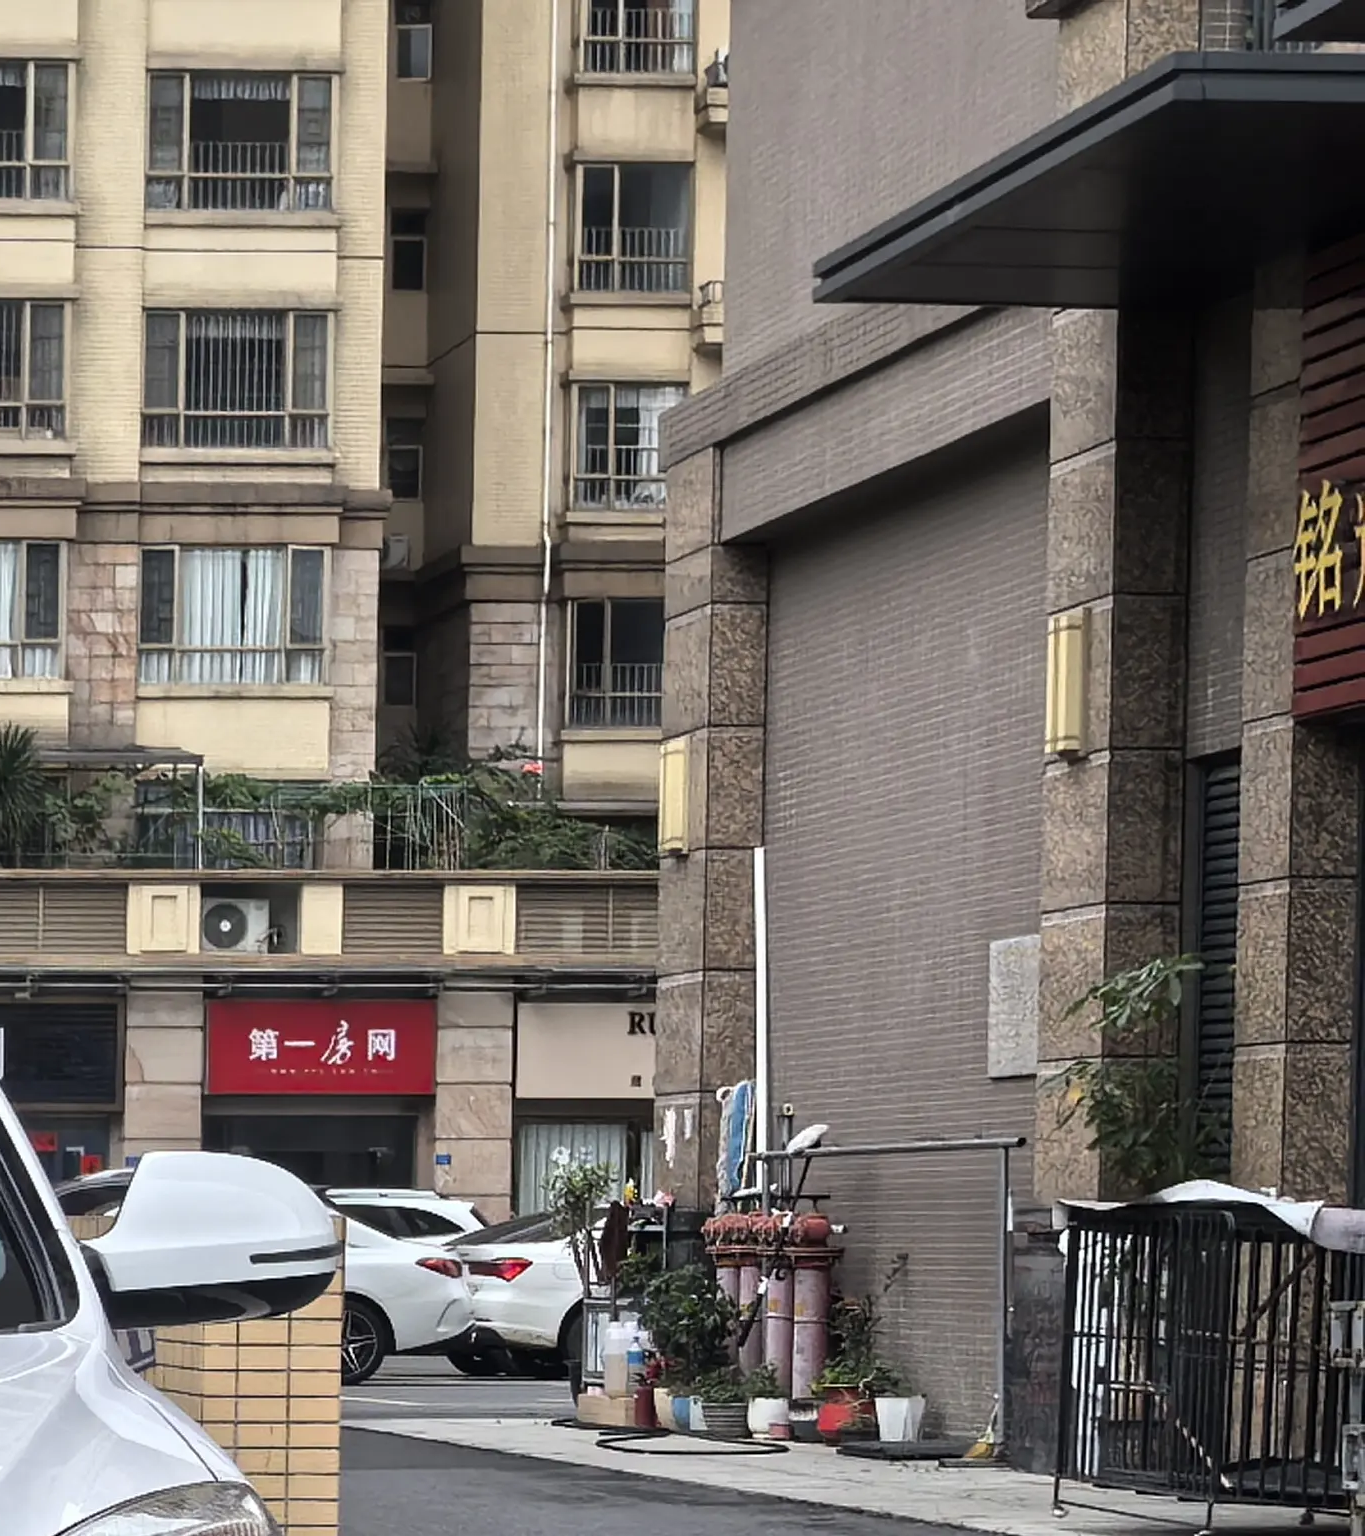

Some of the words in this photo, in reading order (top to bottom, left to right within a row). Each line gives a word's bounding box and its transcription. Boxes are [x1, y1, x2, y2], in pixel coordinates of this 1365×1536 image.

[1292, 479, 1365, 622] 铭
[248, 1019, 396, 1065] 第一房网
